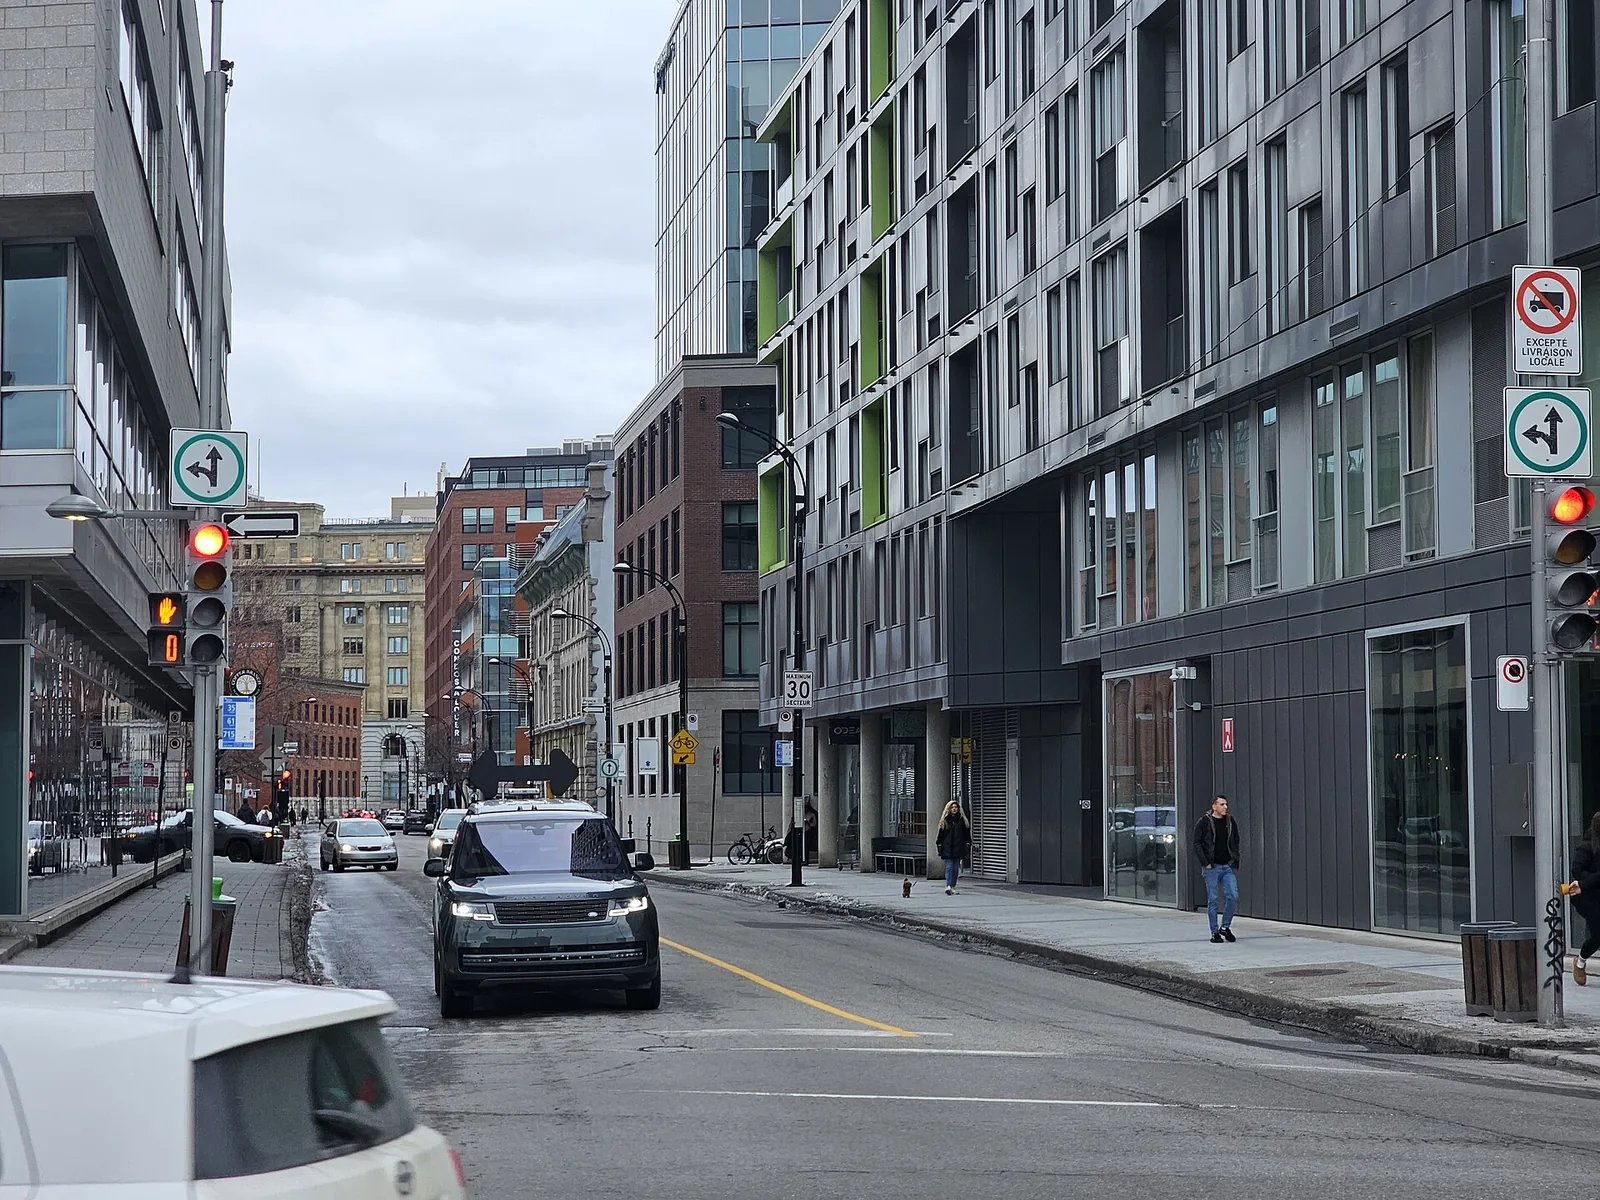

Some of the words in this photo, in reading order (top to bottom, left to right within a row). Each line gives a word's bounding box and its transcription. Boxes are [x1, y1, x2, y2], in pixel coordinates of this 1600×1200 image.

[1526, 337, 1568, 347] EXCEPTÉ
[1521, 348, 1573, 357] LIVRAISON
[1529, 357, 1565, 366] LOCALE
[166, 634, 178, 662] 0
[787, 681, 810, 698] 30
[227, 704, 236, 712] 35
[226, 717, 235, 725] 61
[223, 730, 235, 738] 715
